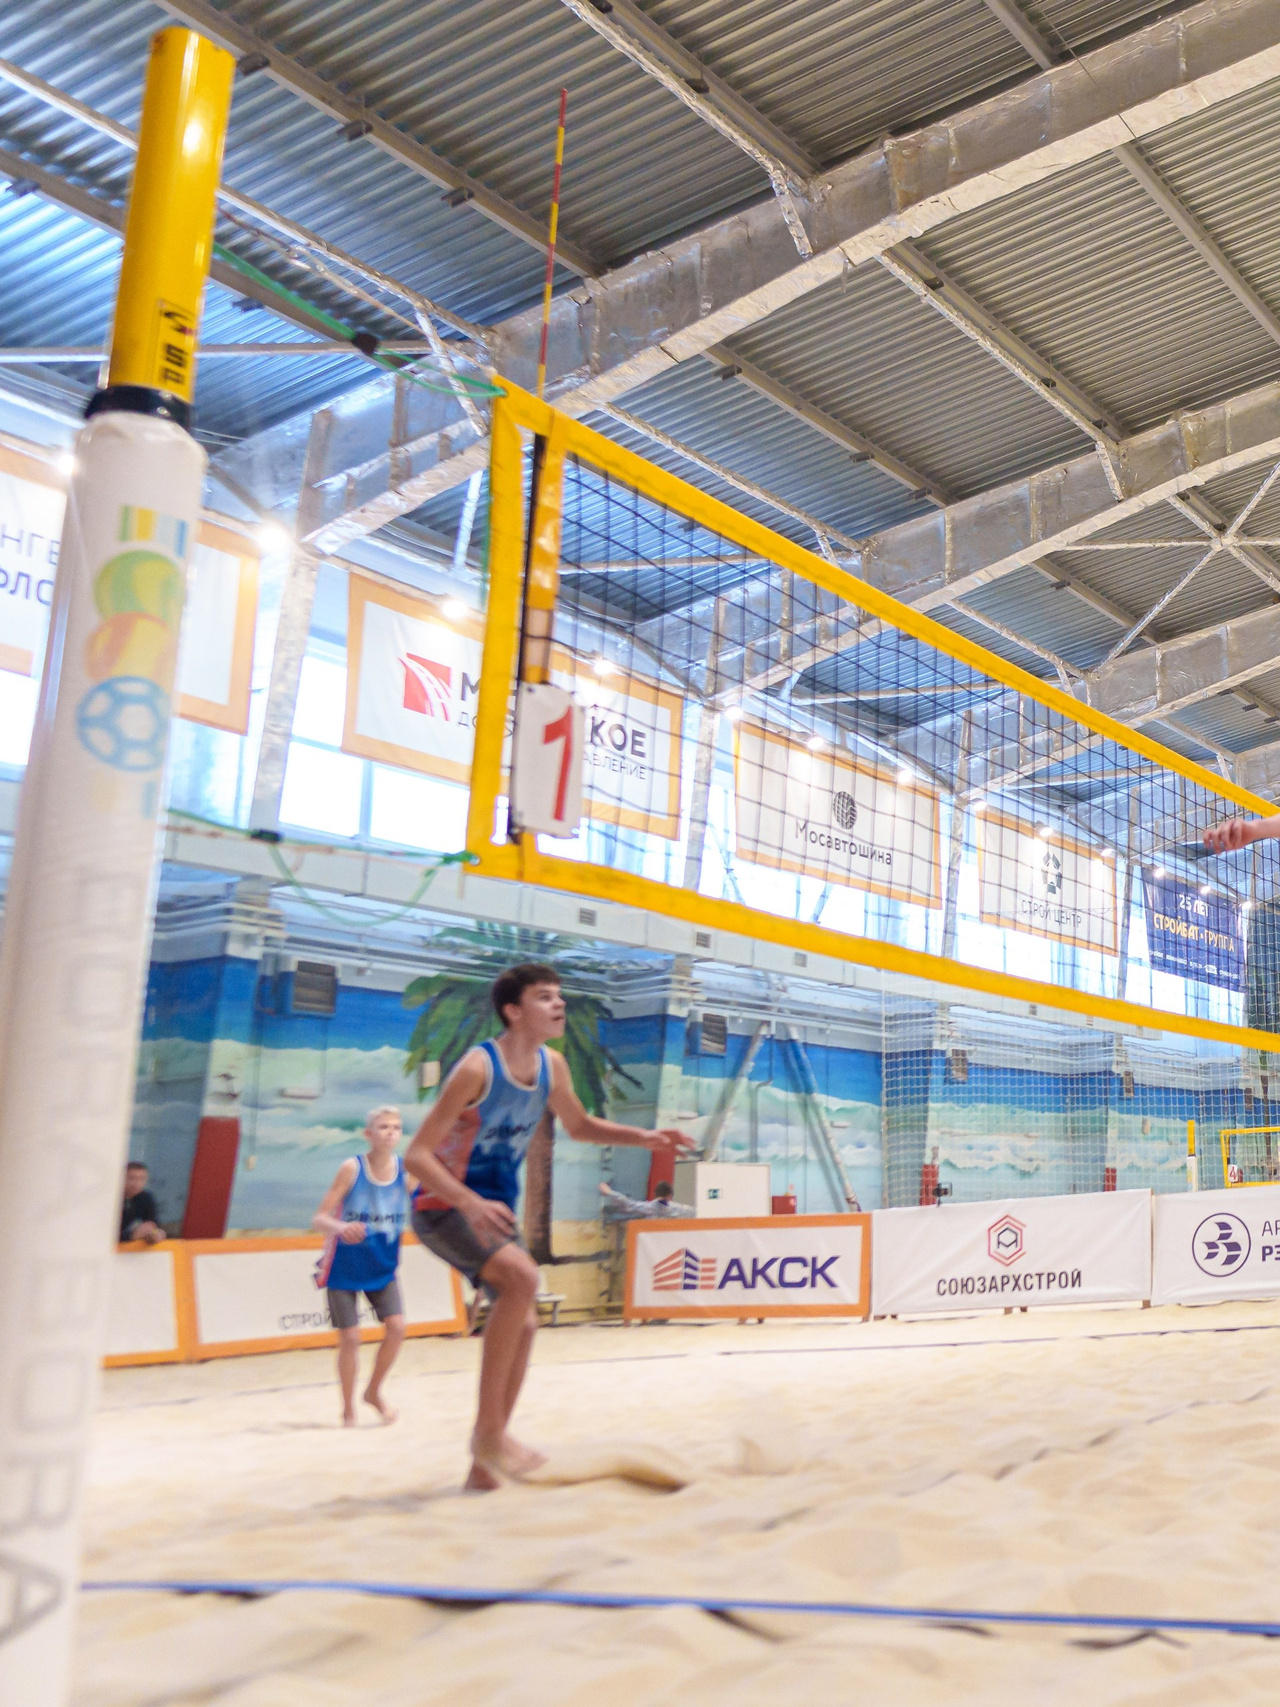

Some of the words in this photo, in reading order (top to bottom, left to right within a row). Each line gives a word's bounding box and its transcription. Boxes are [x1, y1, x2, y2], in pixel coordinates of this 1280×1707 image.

[543, 704, 574, 822] 1
[583, 755, 647, 781] АВЛЕНИЕ
[795, 819, 892, 865] Мосавтошина
[1021, 899, 1052, 921] СТРОЙ
[1054, 908, 1082, 929] ЦЕНТР
[1178, 893, 1192, 911] 25
[1193, 899, 1209, 917] ЛЕТ
[1153, 913, 1200, 941] СТРОЙБАТ
[1229, 1166, 1237, 1180] 4
[717, 1255, 841, 1290] АКСК
[937, 1268, 1082, 1297] СОЮЗАРХСТРОЙ
